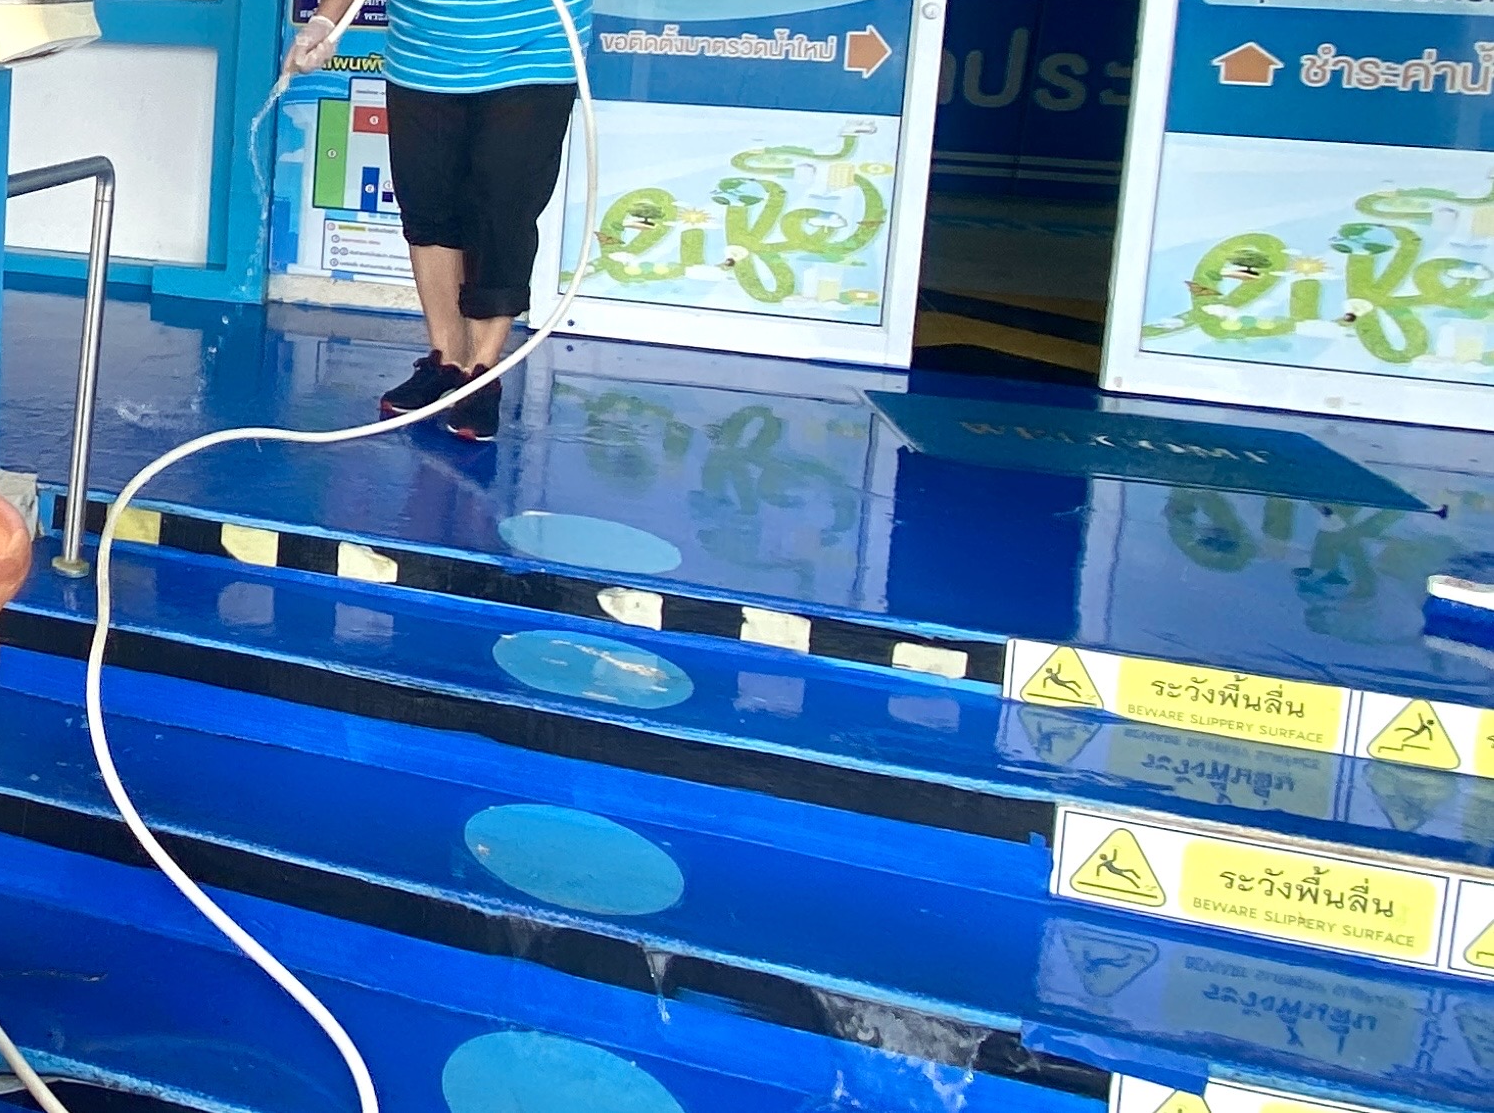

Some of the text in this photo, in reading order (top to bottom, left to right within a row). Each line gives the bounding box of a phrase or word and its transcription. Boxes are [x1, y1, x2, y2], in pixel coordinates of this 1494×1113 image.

[1151, 674, 1305, 719] ระวังพื้นลื่น
[1127, 703, 1324, 744] BEWARE SLIPPERY SURFACE
[1219, 866, 1395, 918] ระวังพื้นลื่น
[1193, 897, 1415, 947] BEWARE SLIPPERY SURFACE
